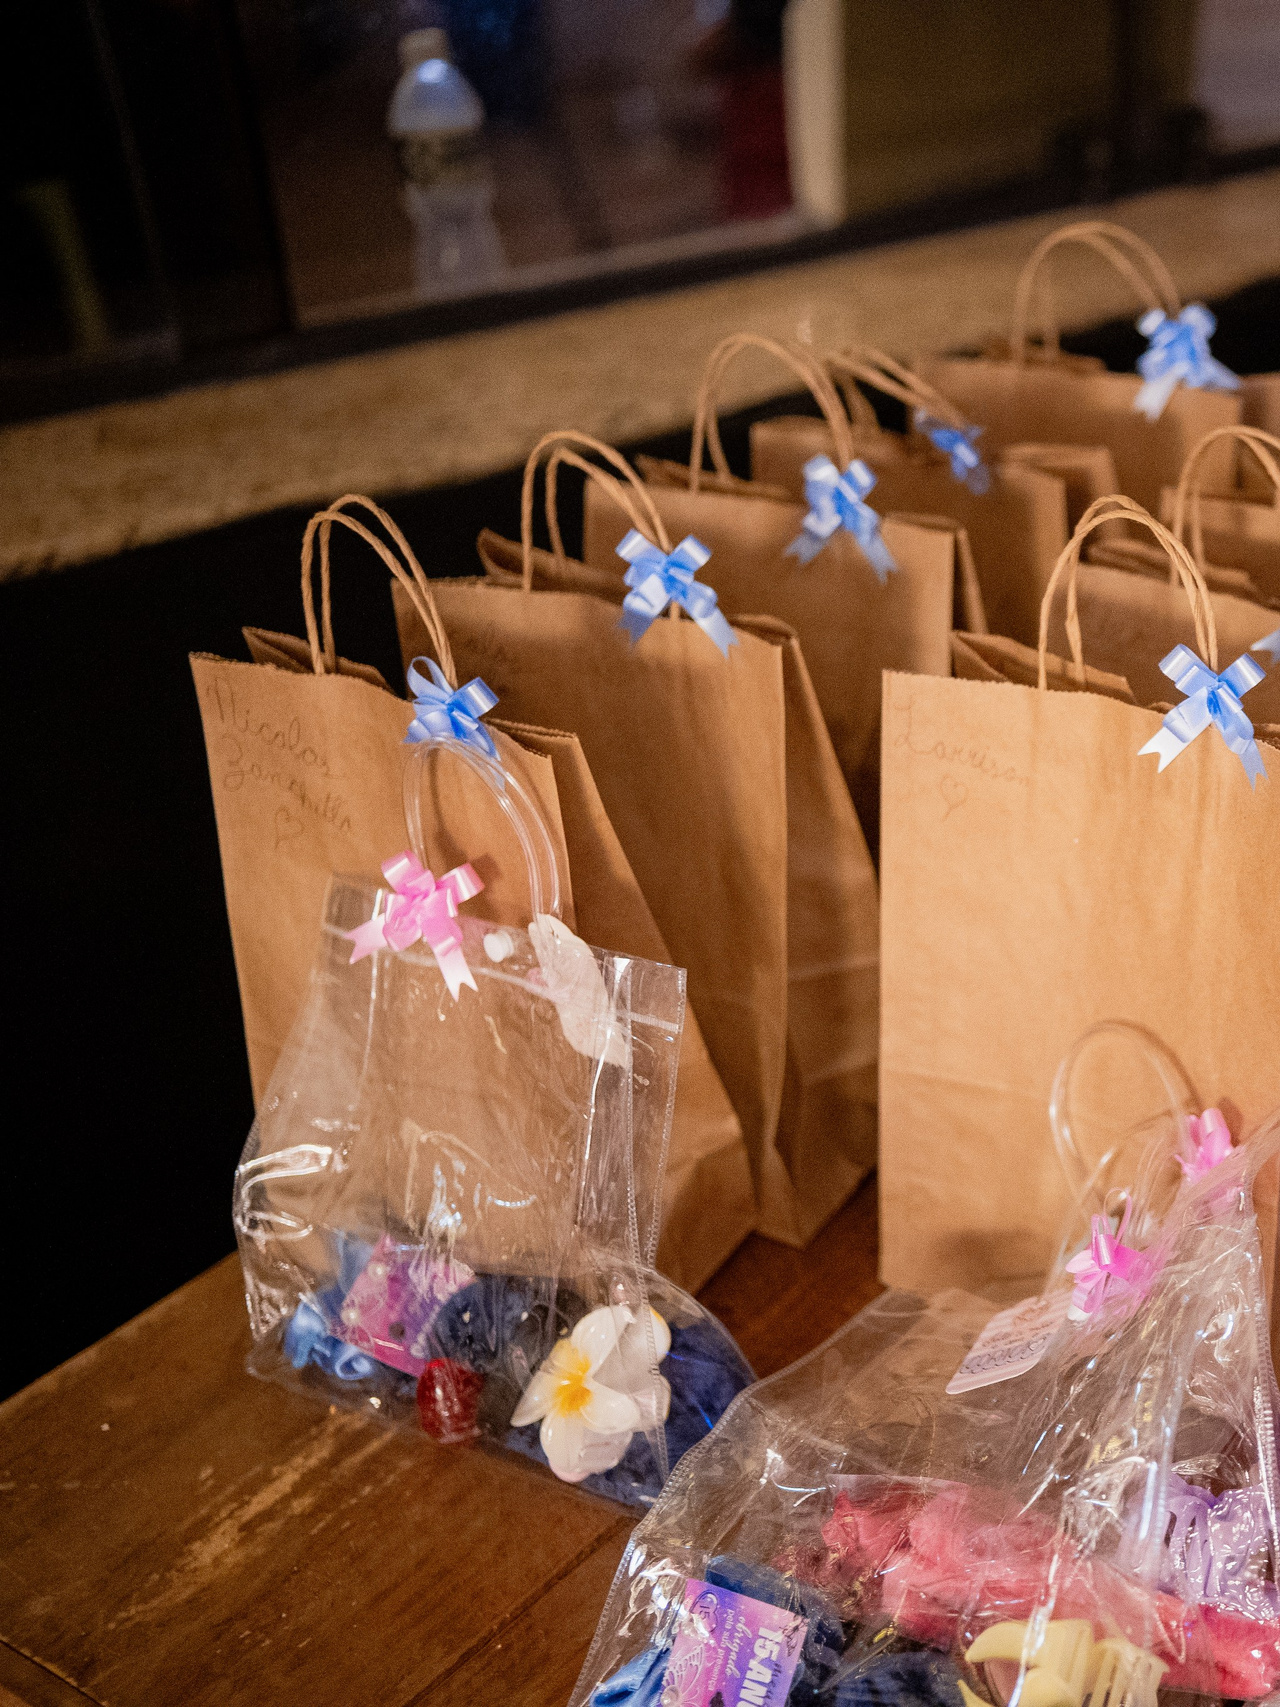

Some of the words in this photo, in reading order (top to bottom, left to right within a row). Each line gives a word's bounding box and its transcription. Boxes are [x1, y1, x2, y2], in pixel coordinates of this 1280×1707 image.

[723, 1608, 735, 1630] pela
[721, 1630, 731, 1648] sua
[725, 1616, 753, 1679] obrigado
[753, 1626, 784, 1662] 15
[707, 1648, 725, 1692] presença
